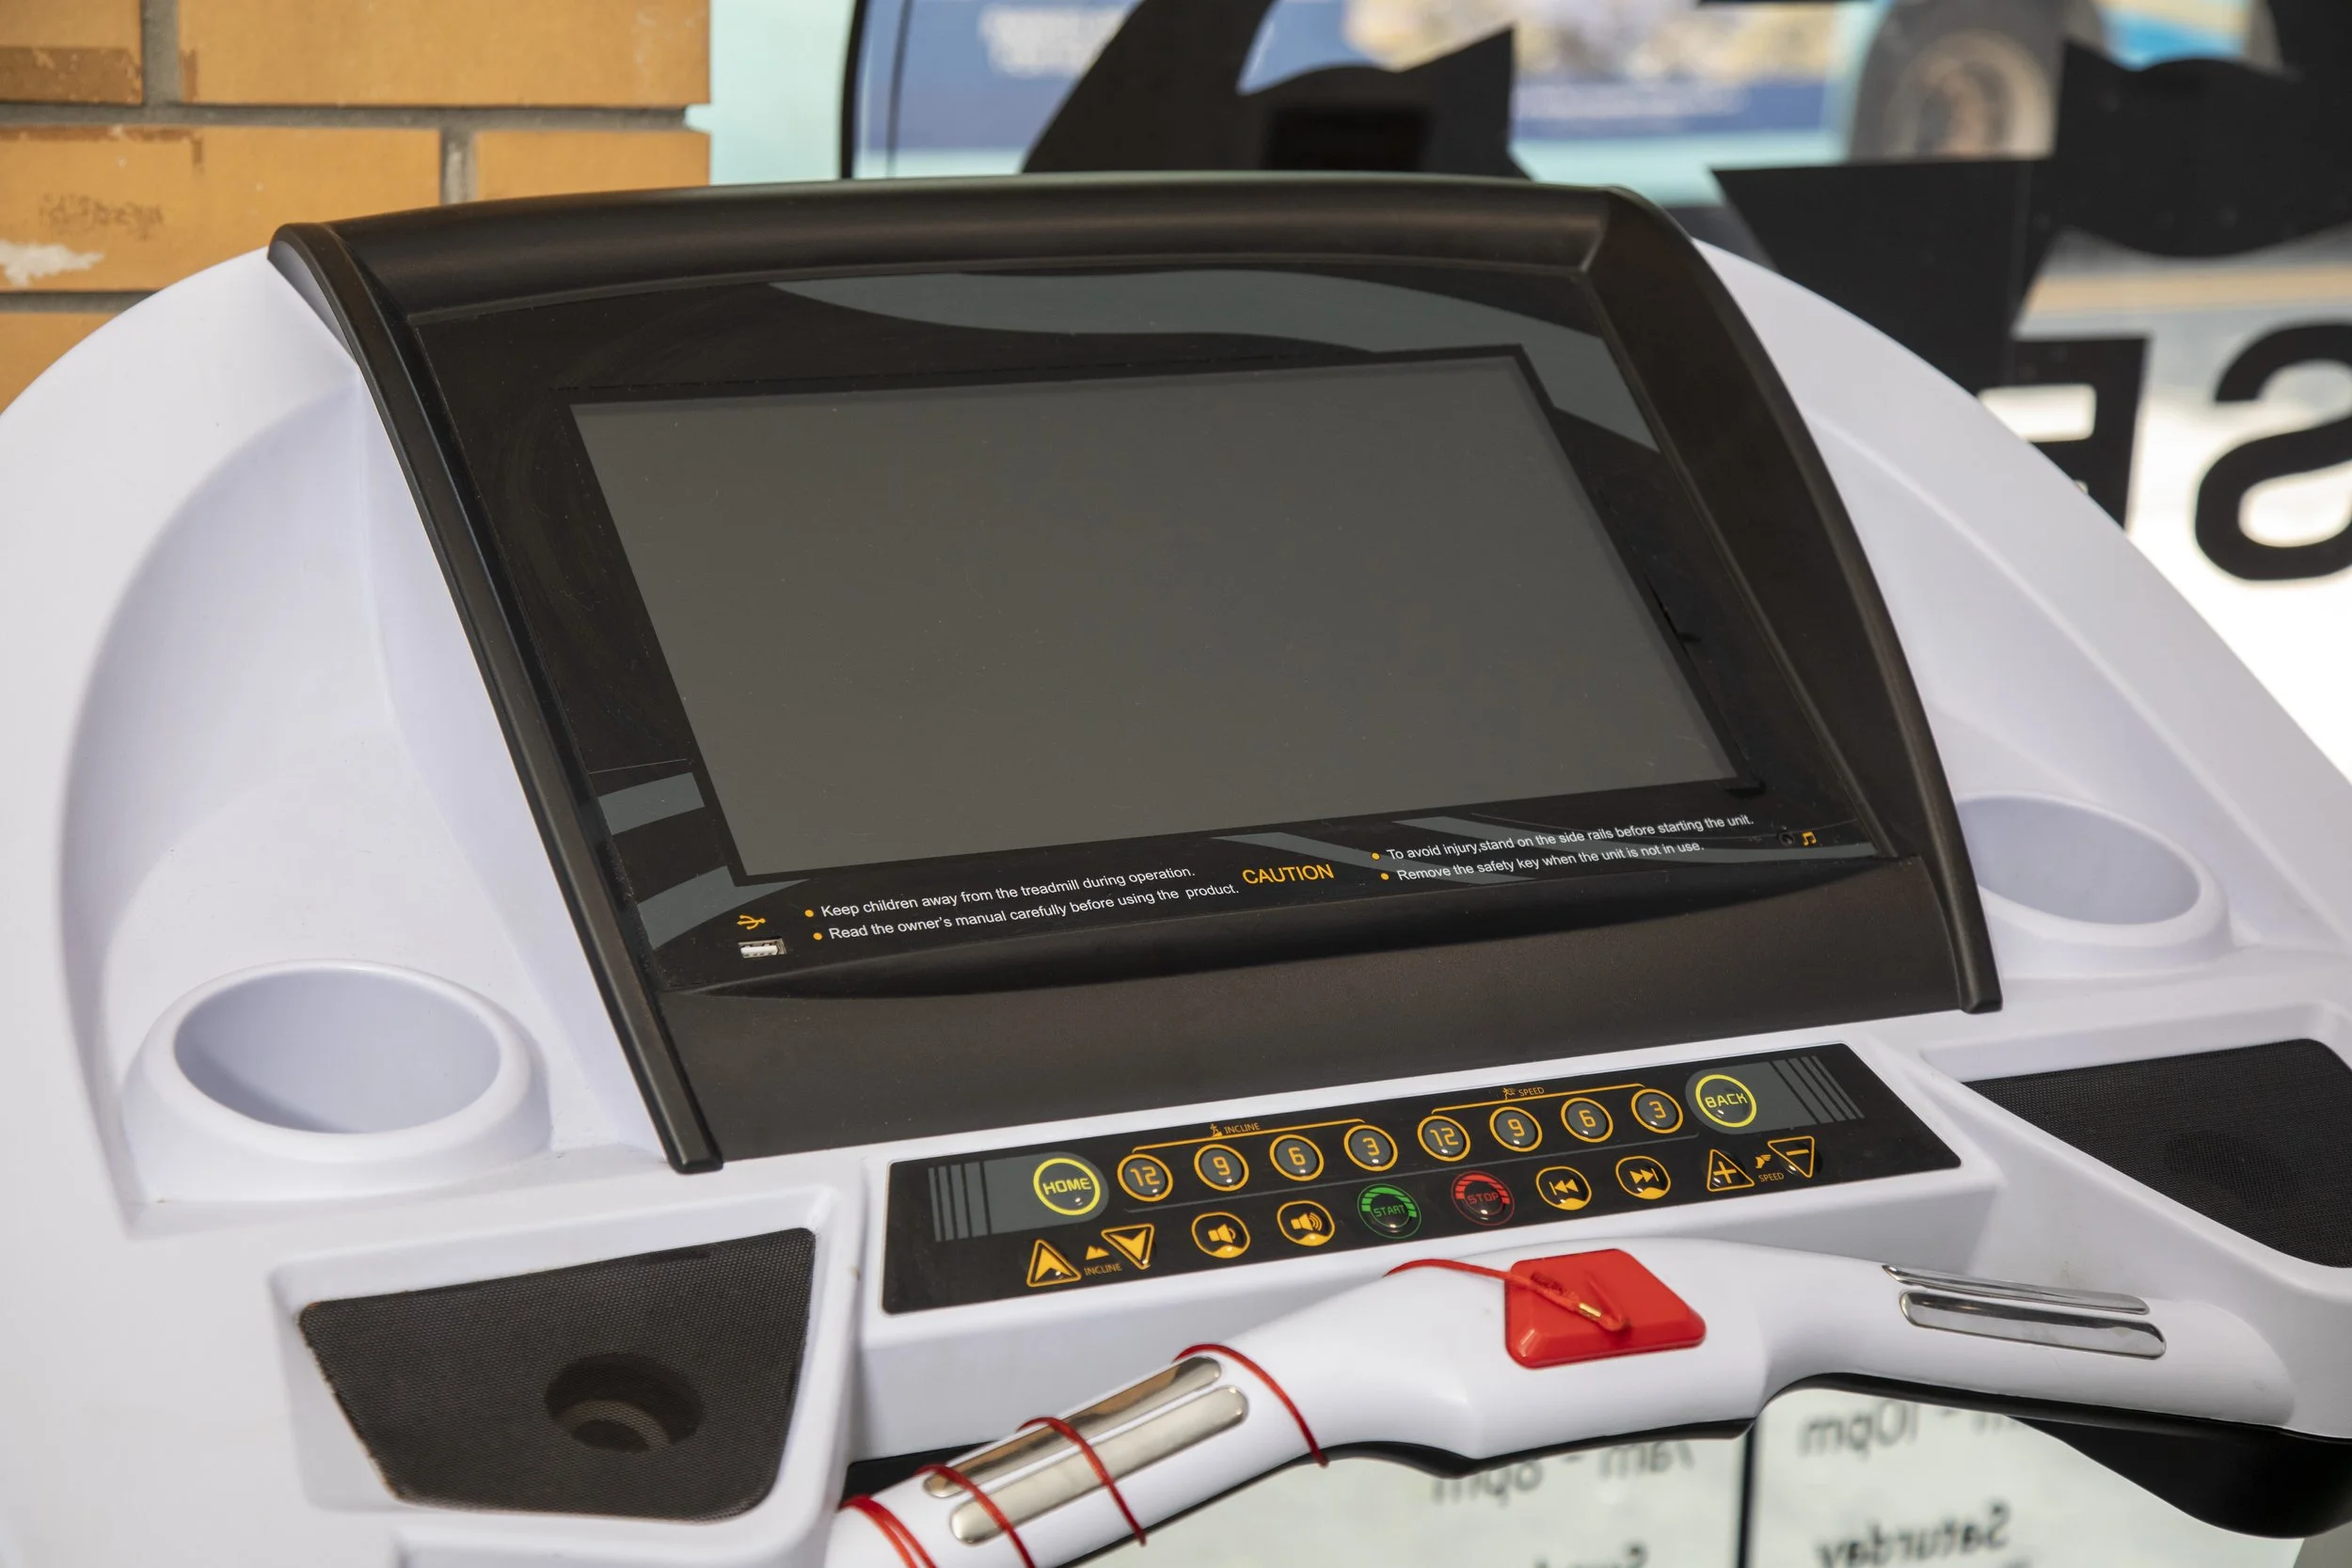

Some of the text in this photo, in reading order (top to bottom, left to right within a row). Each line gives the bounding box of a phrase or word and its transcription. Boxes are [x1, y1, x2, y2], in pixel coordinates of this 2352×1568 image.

[1387, 815, 1755, 860] To avoid injury,stand on the side rails before starting the unit.
[1397, 841, 1705, 881] Remove the safety key when the unit is not in use.
[1242, 863, 1335, 884] CAUTION
[820, 866, 1196, 917] Keep children away from the treadmill during operation.
[828, 883, 1240, 941] Read the owner's manual carefully before using the product.
[1518, 1086, 1545, 1097] SPEED
[1704, 1092, 1748, 1108] BACK
[1578, 1109, 1597, 1129] 6
[1648, 1101, 1667, 1119] 3
[1223, 1122, 1261, 1135] INCLINE
[1430, 1127, 1460, 1147] 12
[1507, 1117, 1526, 1137] 9
[1288, 1146, 1307, 1166] 6
[1362, 1136, 1380, 1156] 3
[1213, 1155, 1232, 1176] 9
[1129, 1165, 1161, 1187] 12
[1757, 1172, 1785, 1183] SPEED
[1042, 1177, 1093, 1196] HOME
[1466, 1192, 1499, 1204] STOP
[1374, 1204, 1406, 1217] START
[1083, 1262, 1123, 1276] INCLINE
